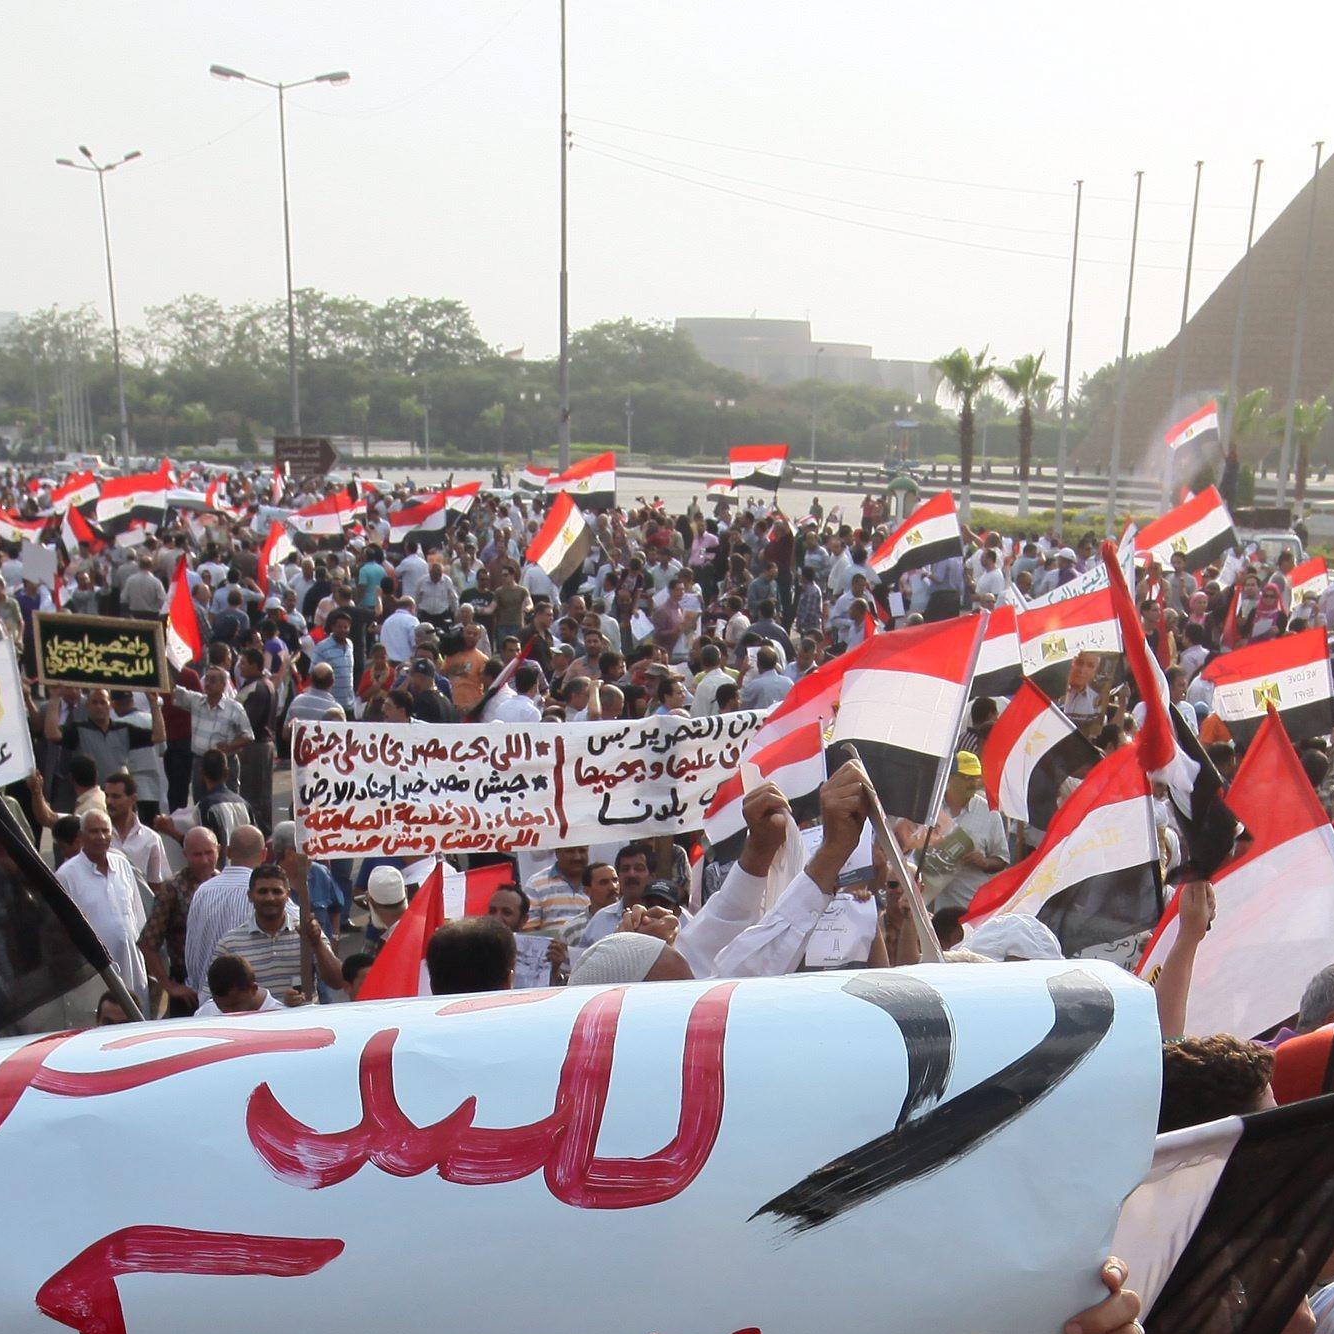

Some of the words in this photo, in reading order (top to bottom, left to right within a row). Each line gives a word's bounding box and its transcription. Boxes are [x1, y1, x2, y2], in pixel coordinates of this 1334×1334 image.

[405, 738, 448, 769] مصر
[450, 735, 490, 772] يحب
[429, 774, 470, 797] مصر
[474, 770, 529, 804] جيش
[597, 787, 689, 826] بلدنا
[748, 968, 1114, 1235] لا
